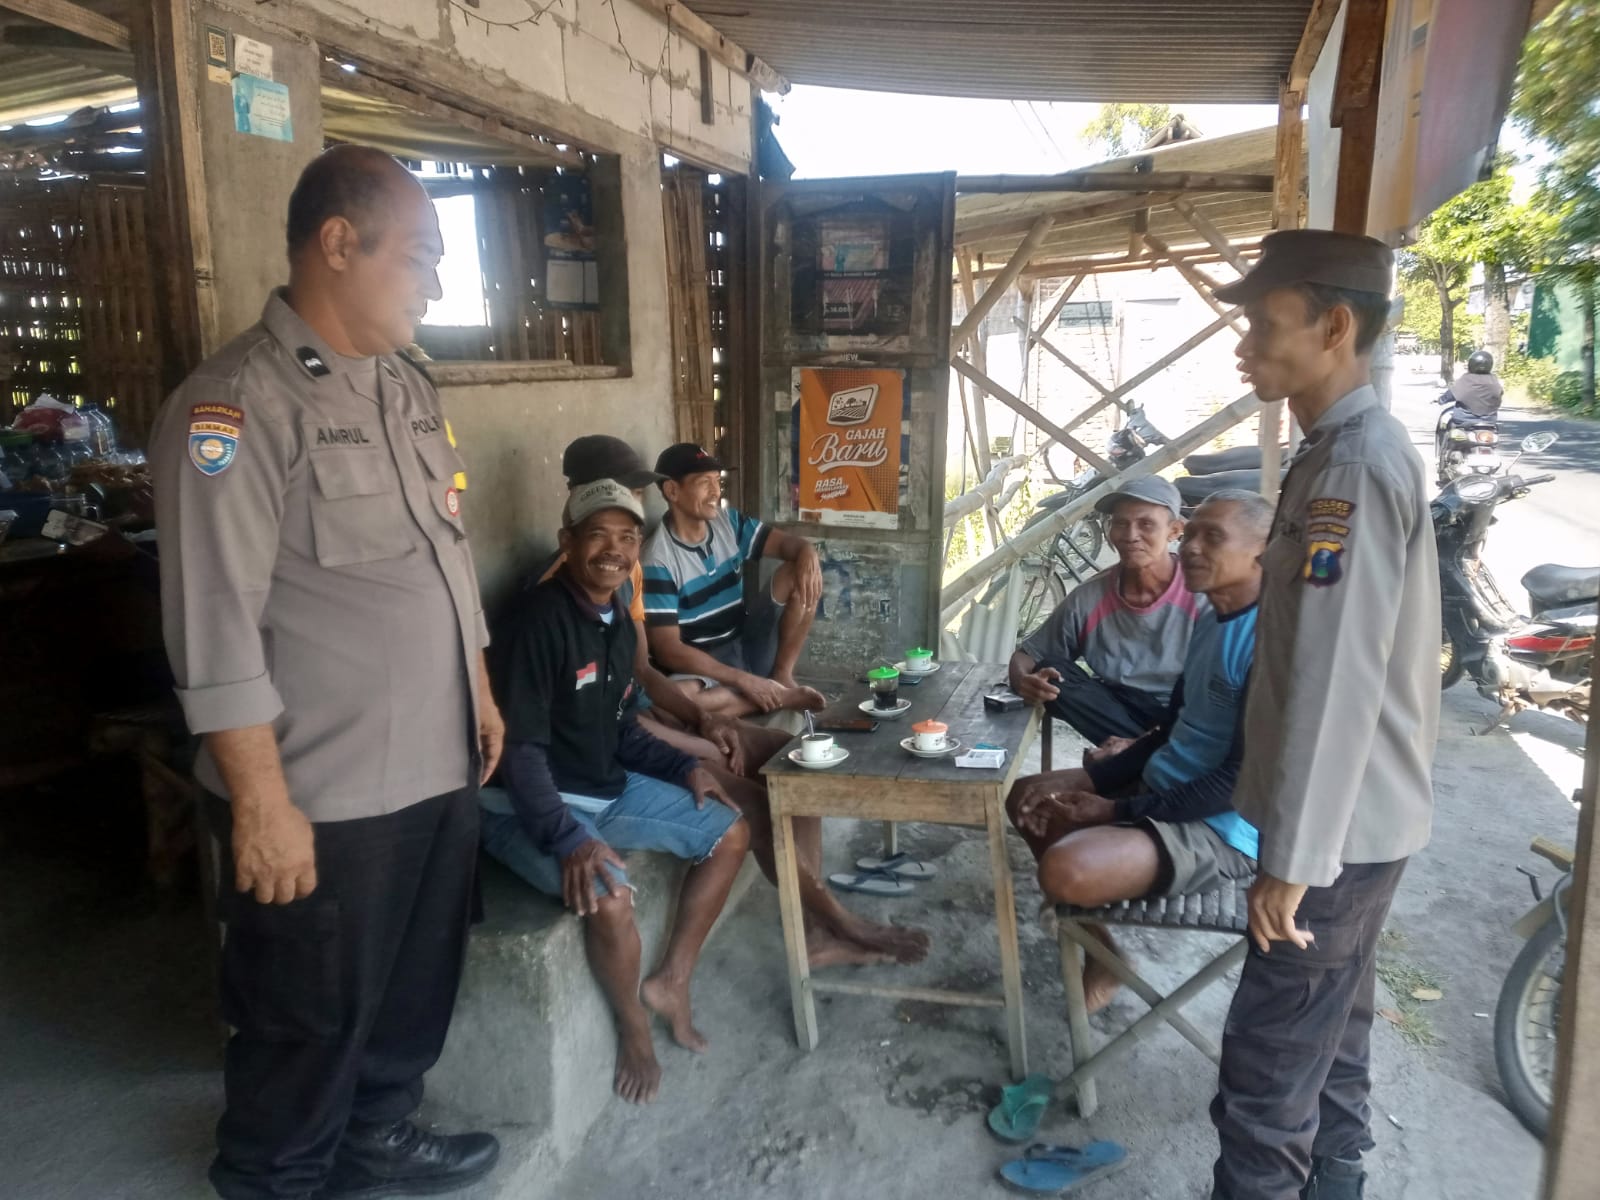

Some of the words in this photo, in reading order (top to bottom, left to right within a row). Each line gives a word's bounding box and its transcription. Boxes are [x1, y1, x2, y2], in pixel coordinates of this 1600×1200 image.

[316, 427, 369, 445] AMRUL
[845, 428, 886, 441] GAJAH
[808, 432, 888, 471] Baru
[815, 476, 843, 489] RASA
